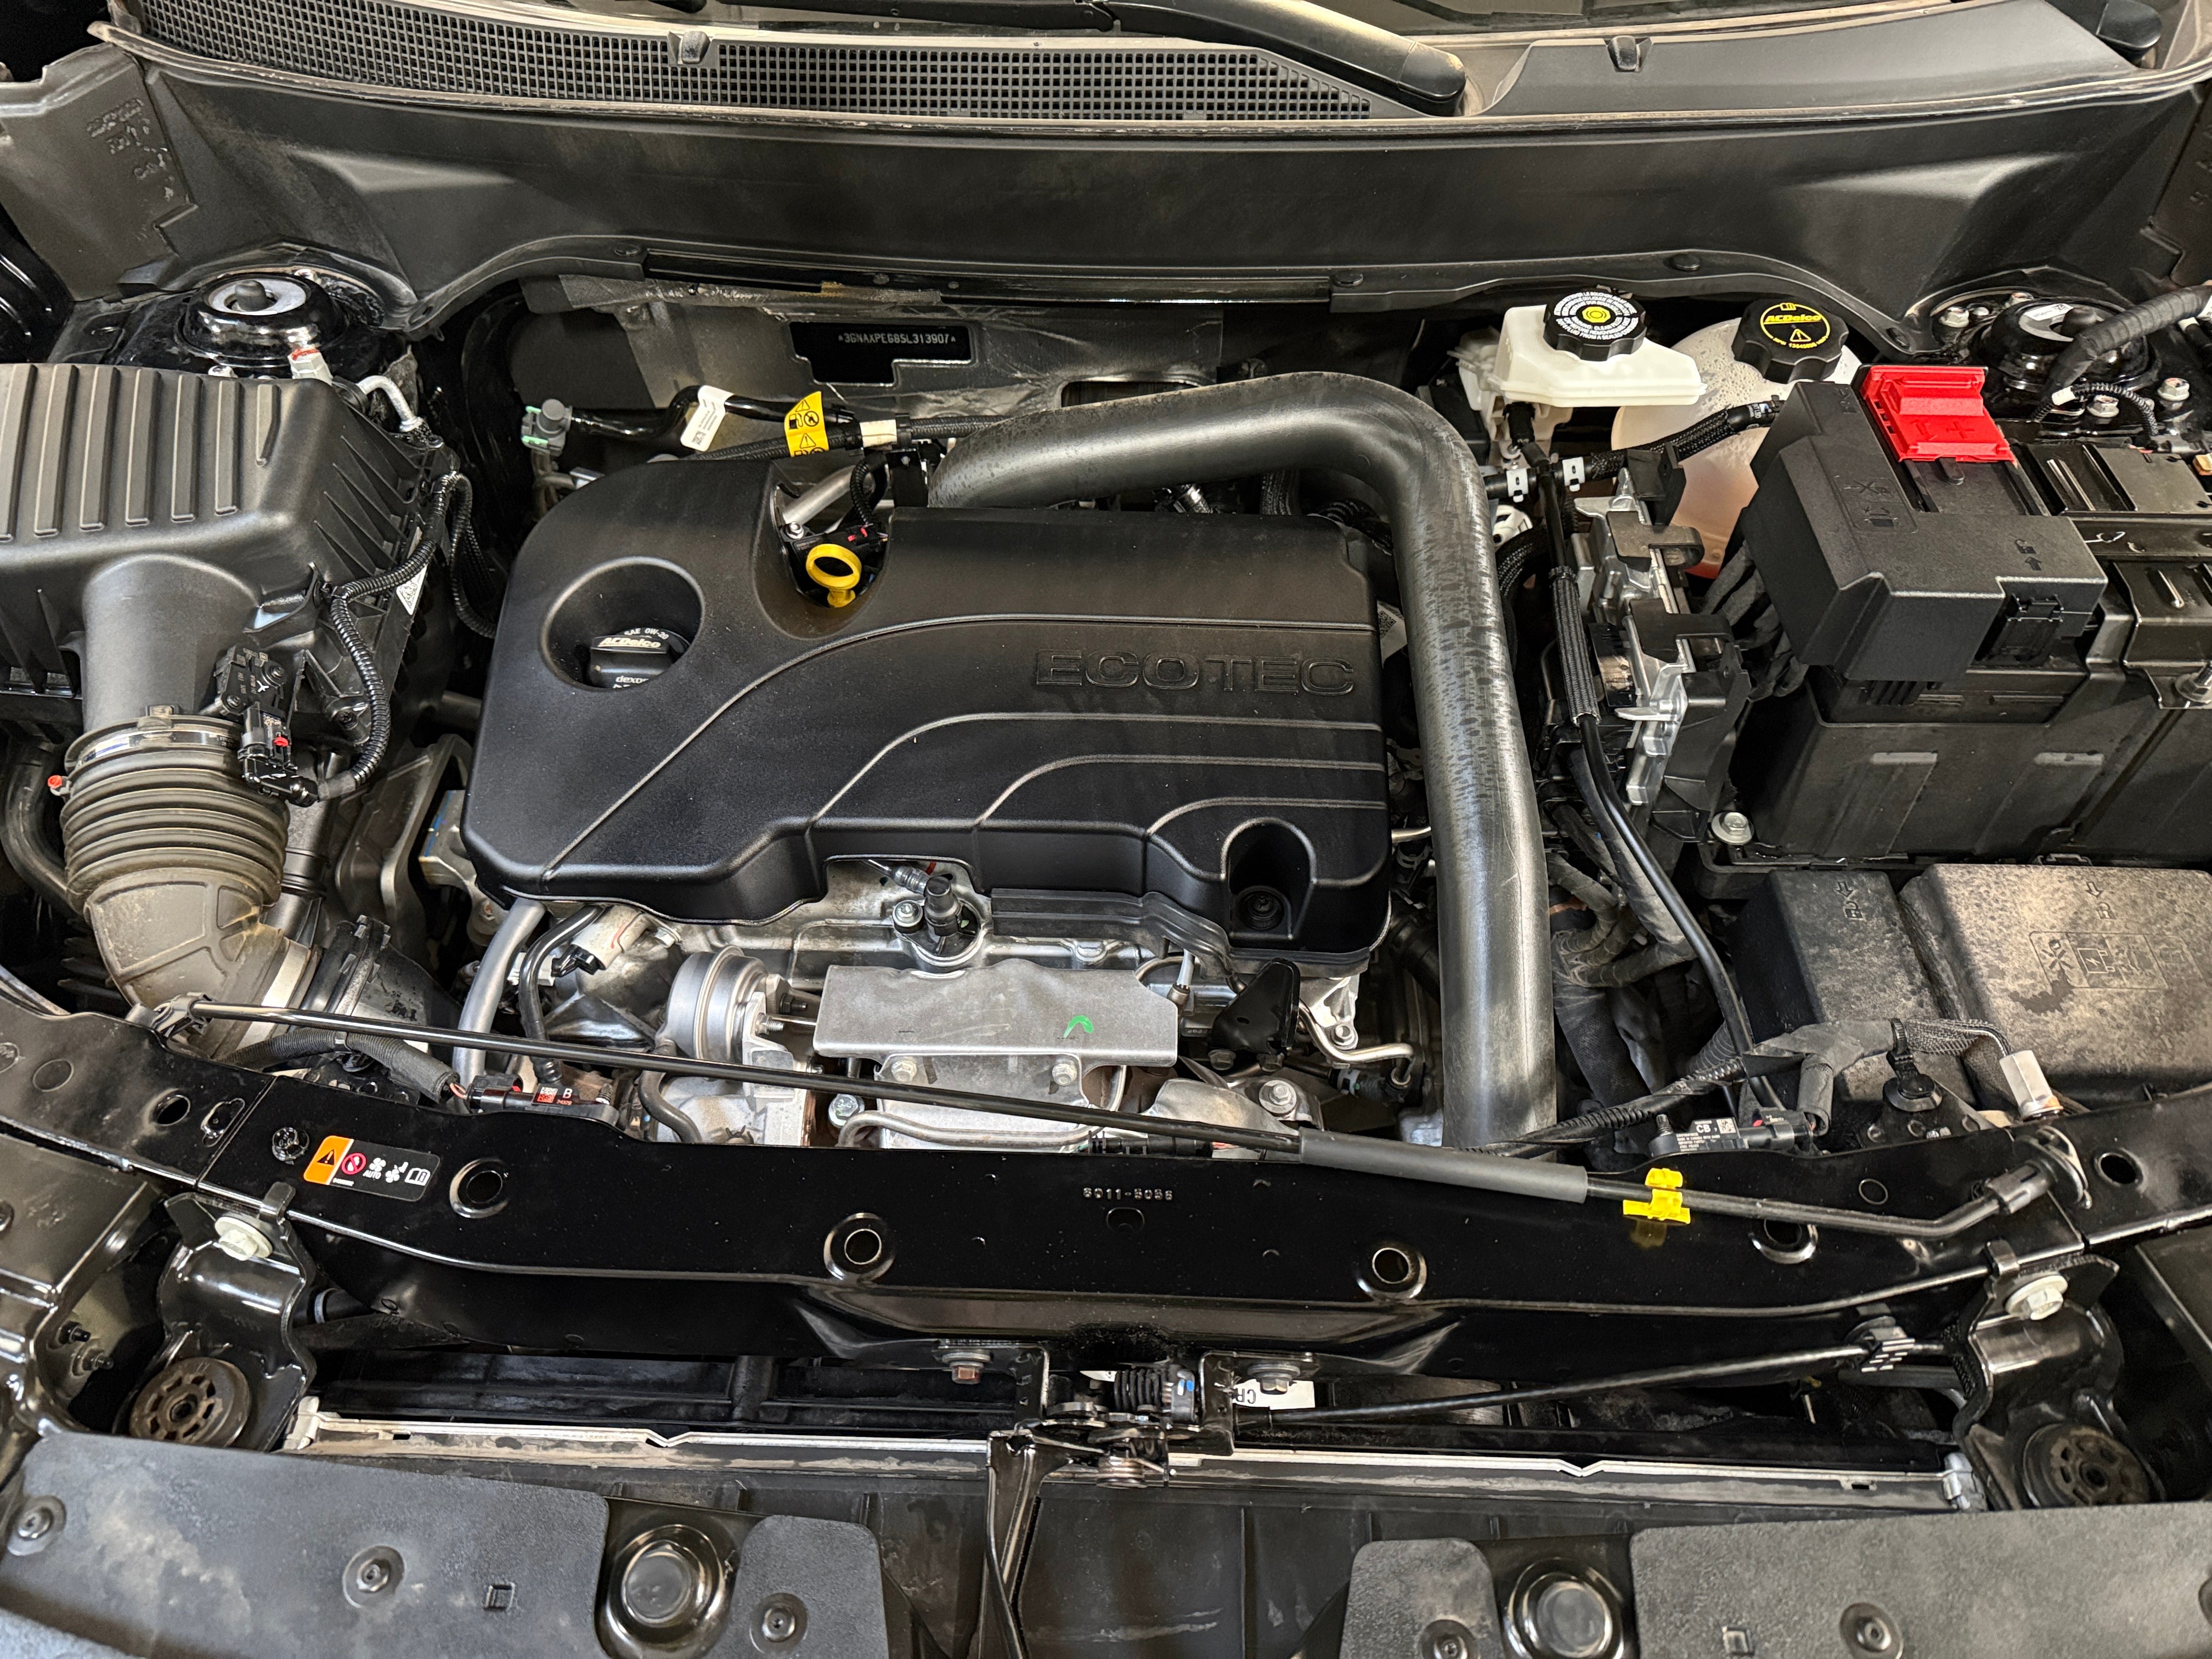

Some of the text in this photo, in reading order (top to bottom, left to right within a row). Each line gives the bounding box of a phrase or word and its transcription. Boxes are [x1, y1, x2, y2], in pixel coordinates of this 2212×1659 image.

[624, 628, 669, 640] SAE 0W-20
[599, 637, 662, 648] ACDelco
[1036, 650, 1355, 696] ECOTEC
[562, 1088, 573, 1099] B
[1696, 1125, 1711, 1133] CB
[363, 1170, 381, 1180] AUTO
